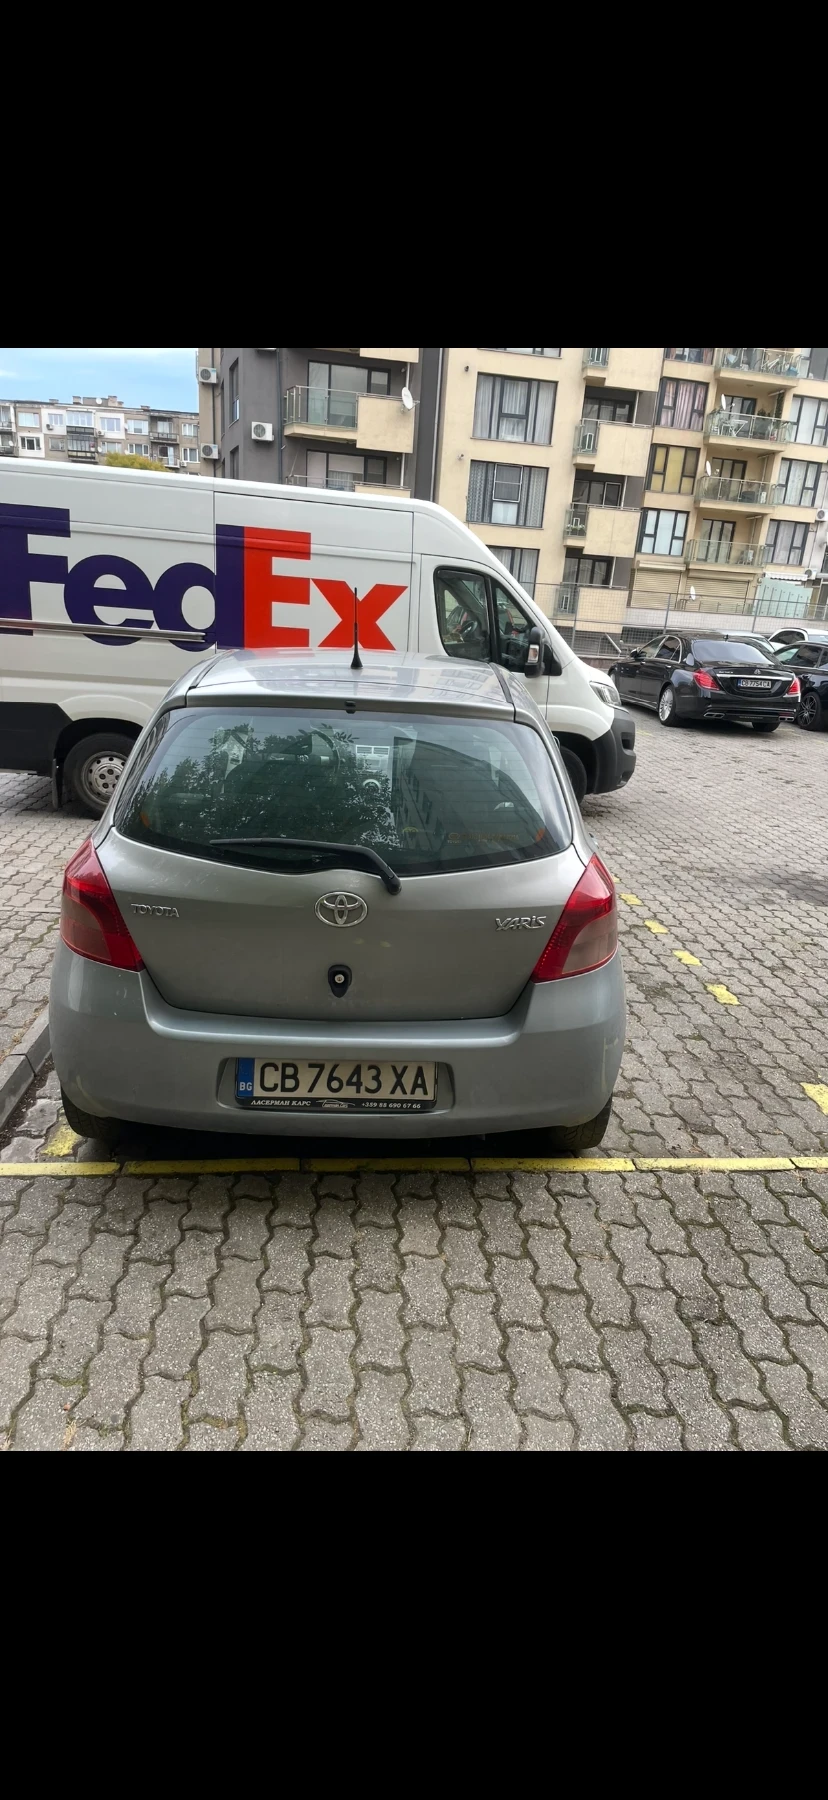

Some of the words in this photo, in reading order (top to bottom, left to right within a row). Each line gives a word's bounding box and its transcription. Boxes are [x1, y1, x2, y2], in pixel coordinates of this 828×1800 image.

[0, 503, 408, 652] FedEx
[130, 903, 180, 917] TOYOTA
[239, 1082, 253, 1091] BG
[259, 1062, 300, 1093] CB
[307, 1063, 383, 1094] 7643
[389, 1065, 429, 1096] XA
